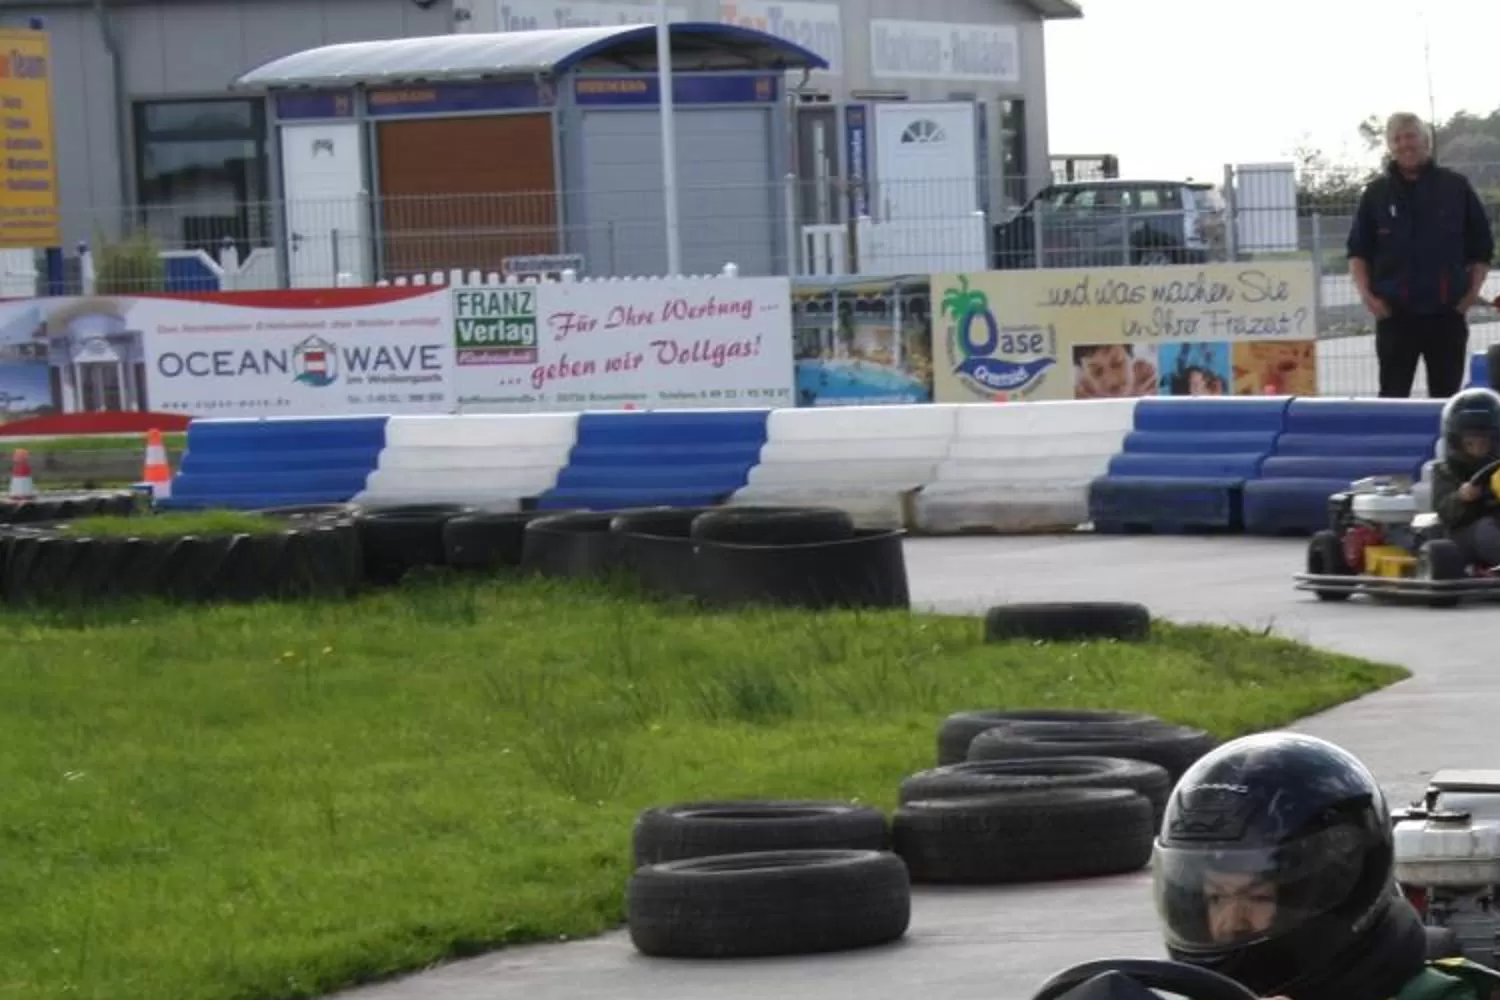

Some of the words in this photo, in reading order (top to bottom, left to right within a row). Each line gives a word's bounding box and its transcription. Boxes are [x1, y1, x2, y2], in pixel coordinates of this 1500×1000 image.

[457, 291, 532, 316] FRANZ
[1094, 279, 1146, 304] was
[1152, 271, 1233, 304] machen
[1240, 270, 1289, 303] Sie
[457, 320, 535, 346] Verlag
[549, 311, 598, 341] Für
[603, 305, 654, 330] Ihre
[662, 297, 753, 322] Werbung
[157, 348, 288, 378] OCEAN
[343, 344, 444, 373] WAVE
[531, 353, 596, 389] geben
[604, 351, 644, 373] wir
[650, 335, 762, 369] Vollgas!
